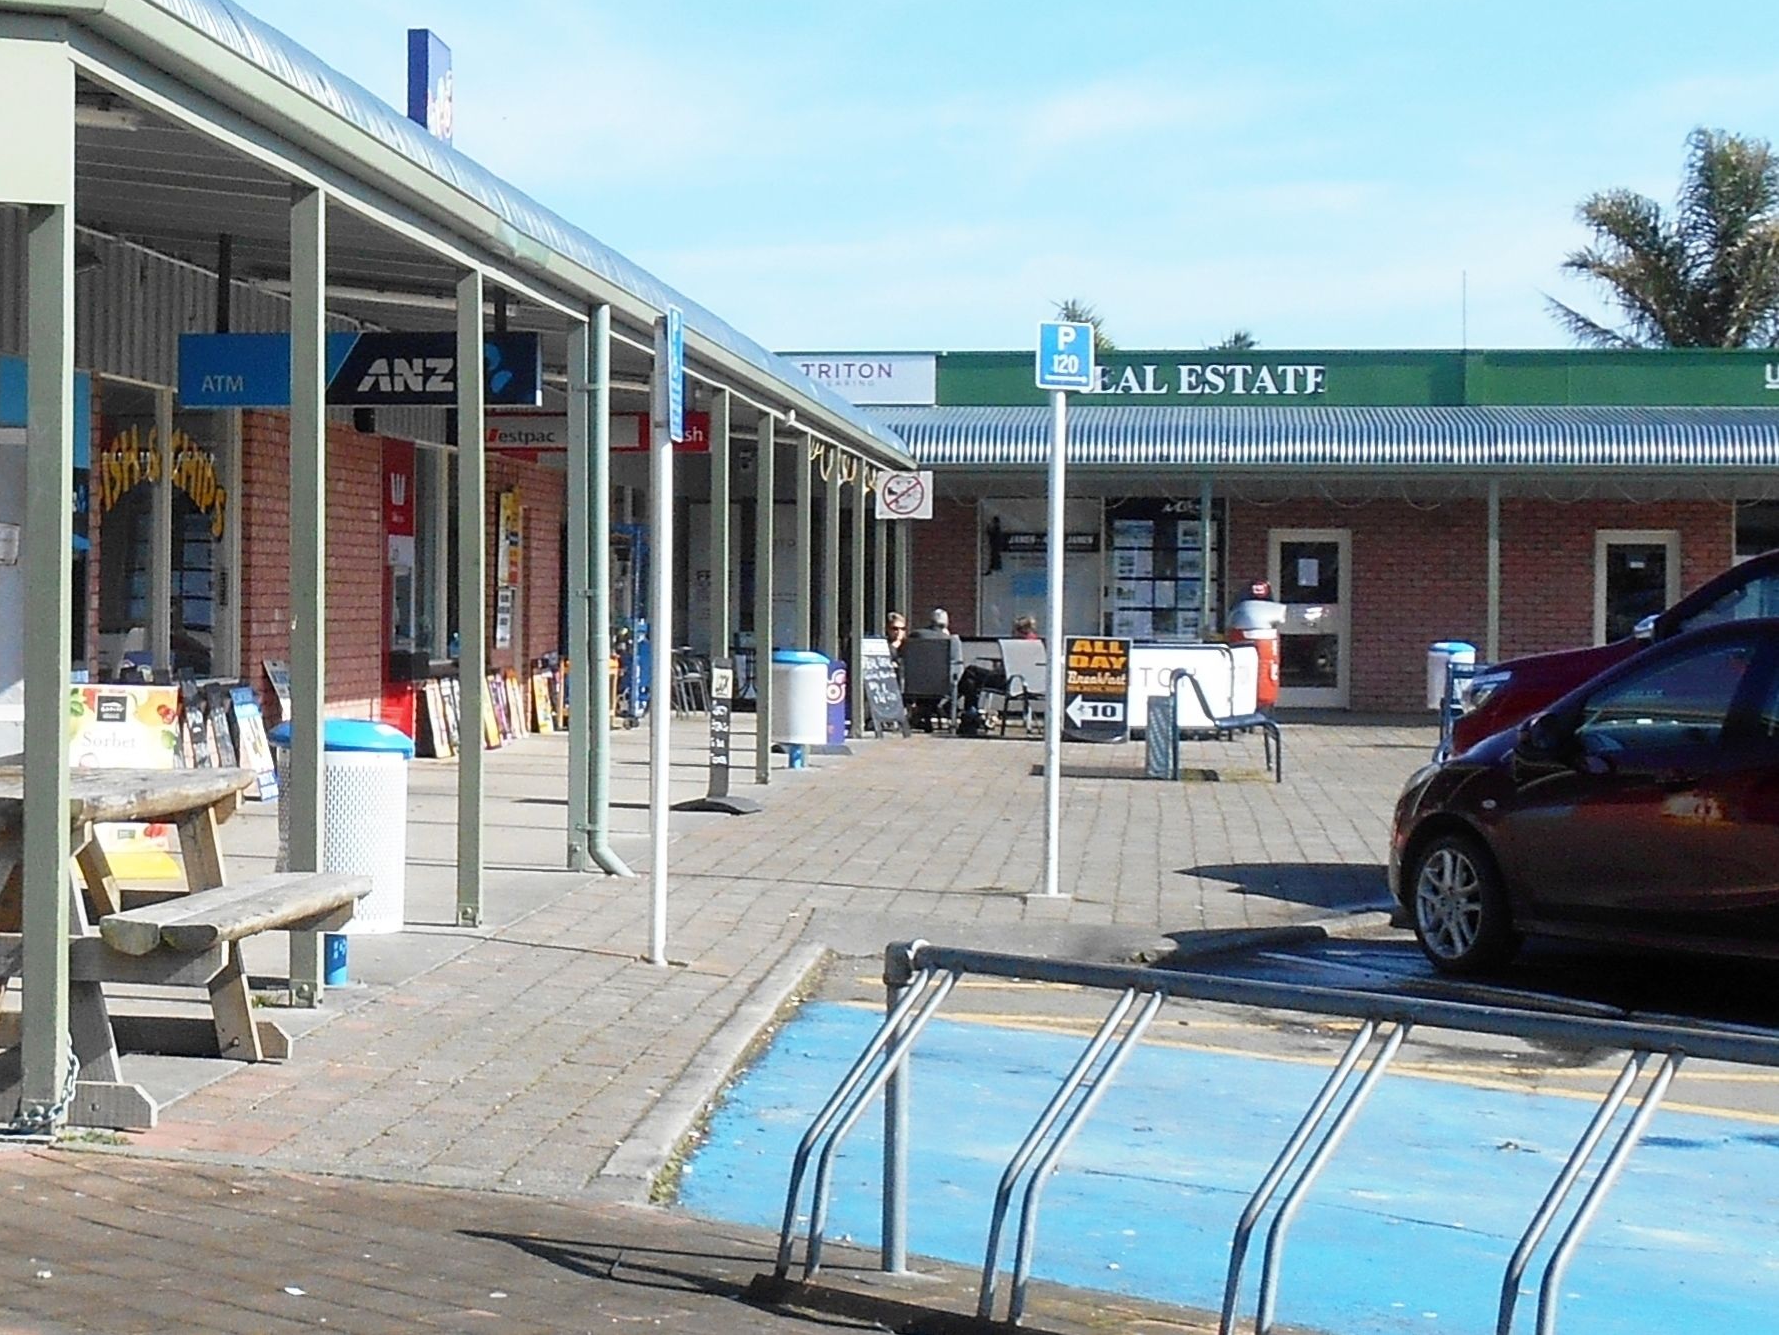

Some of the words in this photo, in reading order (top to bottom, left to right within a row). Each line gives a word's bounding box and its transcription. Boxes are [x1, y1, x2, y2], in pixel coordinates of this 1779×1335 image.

[1057, 326, 1076, 351] P
[801, 363, 892, 379] TRITON
[1052, 355, 1079, 374] 120
[201, 375, 244, 393] ATM
[357, 358, 454, 393] ANZ
[825, 379, 876, 387] EARING
[1081, 364, 1168, 394] EAL
[1176, 364, 1327, 395] ESTATE
[1071, 639, 1125, 654] ALL
[1068, 655, 1127, 669] DAY
[81, 730, 136, 749] Sorbet
